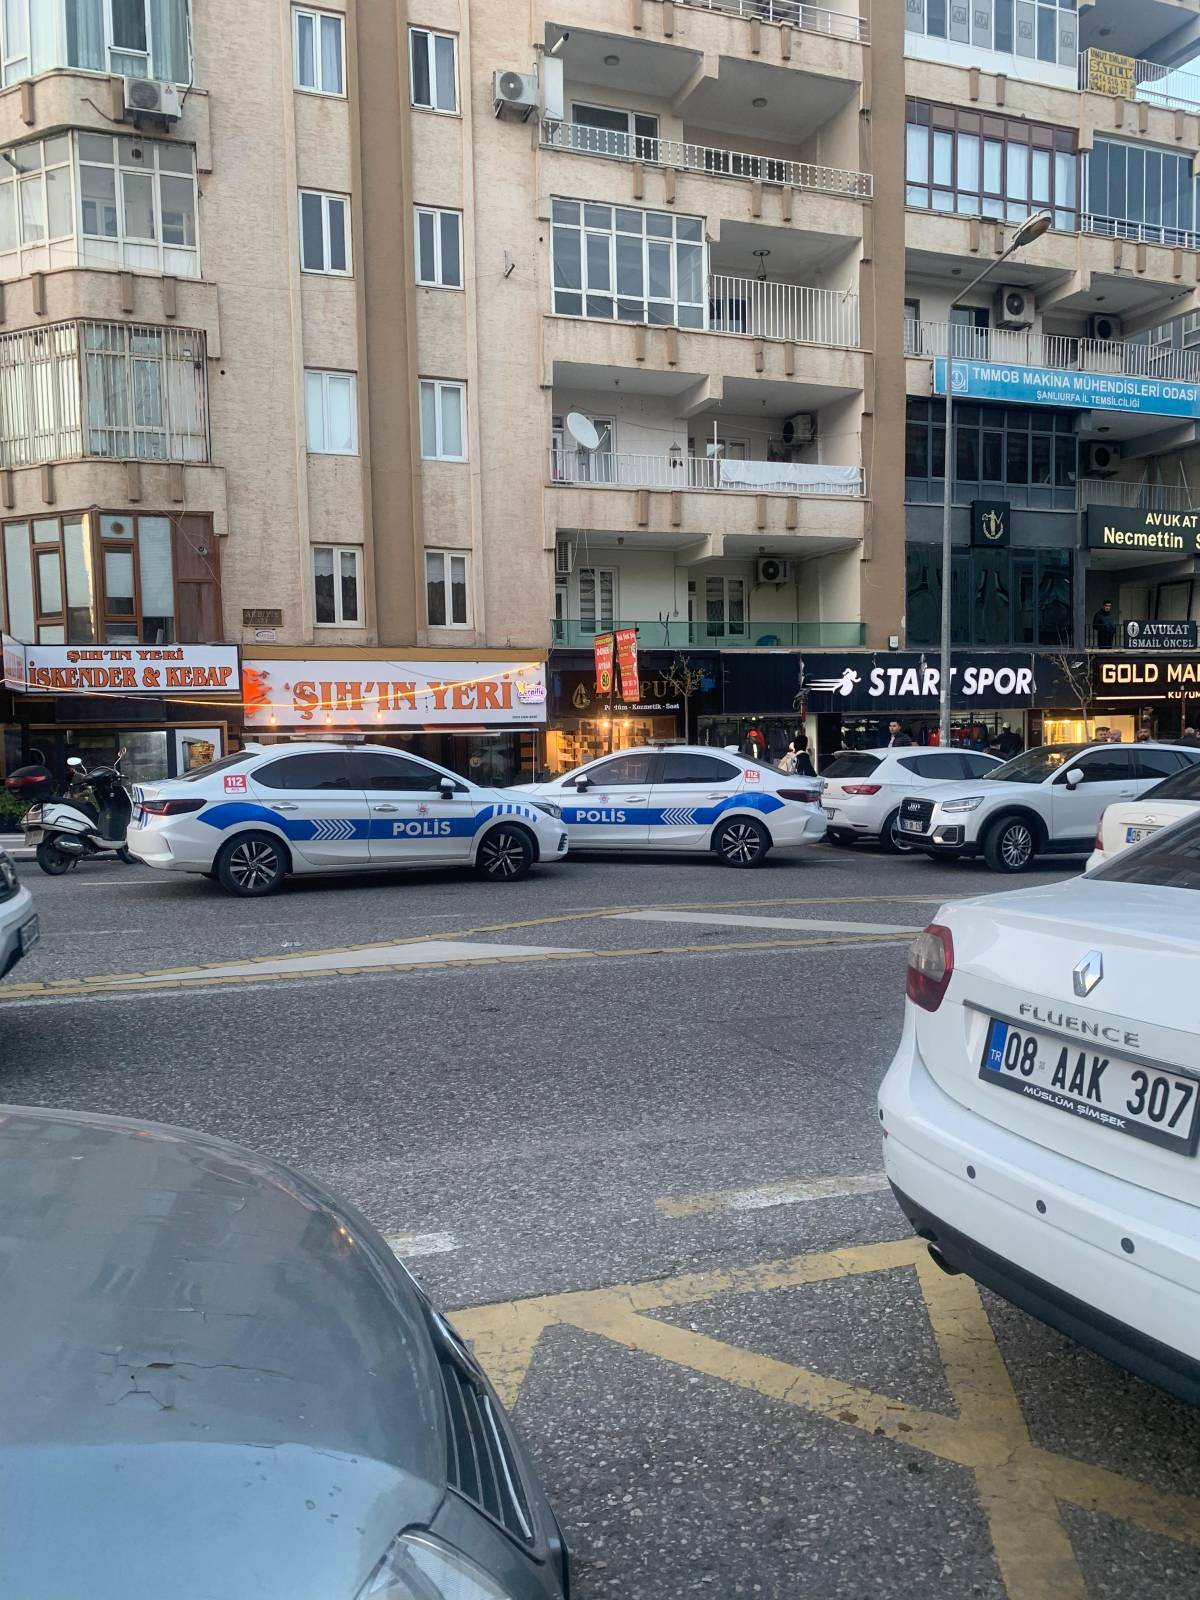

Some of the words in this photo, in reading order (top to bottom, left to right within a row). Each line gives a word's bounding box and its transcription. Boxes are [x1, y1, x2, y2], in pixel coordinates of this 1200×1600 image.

[972, 367, 1019, 384] TMMOB
[1023, 371, 1070, 388] MAKİNA
[1073, 375, 1160, 398] MÜHENDİSLERİ
[1162, 386, 1197, 402] ODASI
[1036, 391, 1081, 403] ŞANLIURFA
[1091, 394, 1140, 408] TEMSİLCİLİĞİ
[1145, 512, 1198, 528] AVUKAT
[1104, 527, 1183, 549] Necmettin
[1143, 624, 1190, 635] AVUKAT
[1128, 637, 1161, 648] İSMAİL
[1163, 637, 1194, 648] ÖNCEL
[136, 647, 184, 661] YERİ
[28, 661, 137, 688] İSKENDER
[142, 666, 161, 687] &
[165, 666, 233, 687] KEBAP
[962, 667, 1033, 696] SPOR
[1102, 663, 1158, 683] GOLD
[427, 673, 513, 709] YERİ
[226, 776, 244, 787] 112
[576, 808, 626, 823] POLİS
[392, 818, 451, 836] POLİS
[1019, 1002, 1141, 1048] FLUENCE
[990, 1048, 1002, 1062] TR
[1004, 1031, 1038, 1077] 08
[1051, 1046, 1109, 1103] AAK
[1126, 1070, 1194, 1128] 307
[1023, 1085, 1074, 1110] MÜSLÜM
[1076, 1104, 1126, 1129] ŞİMŞEK
